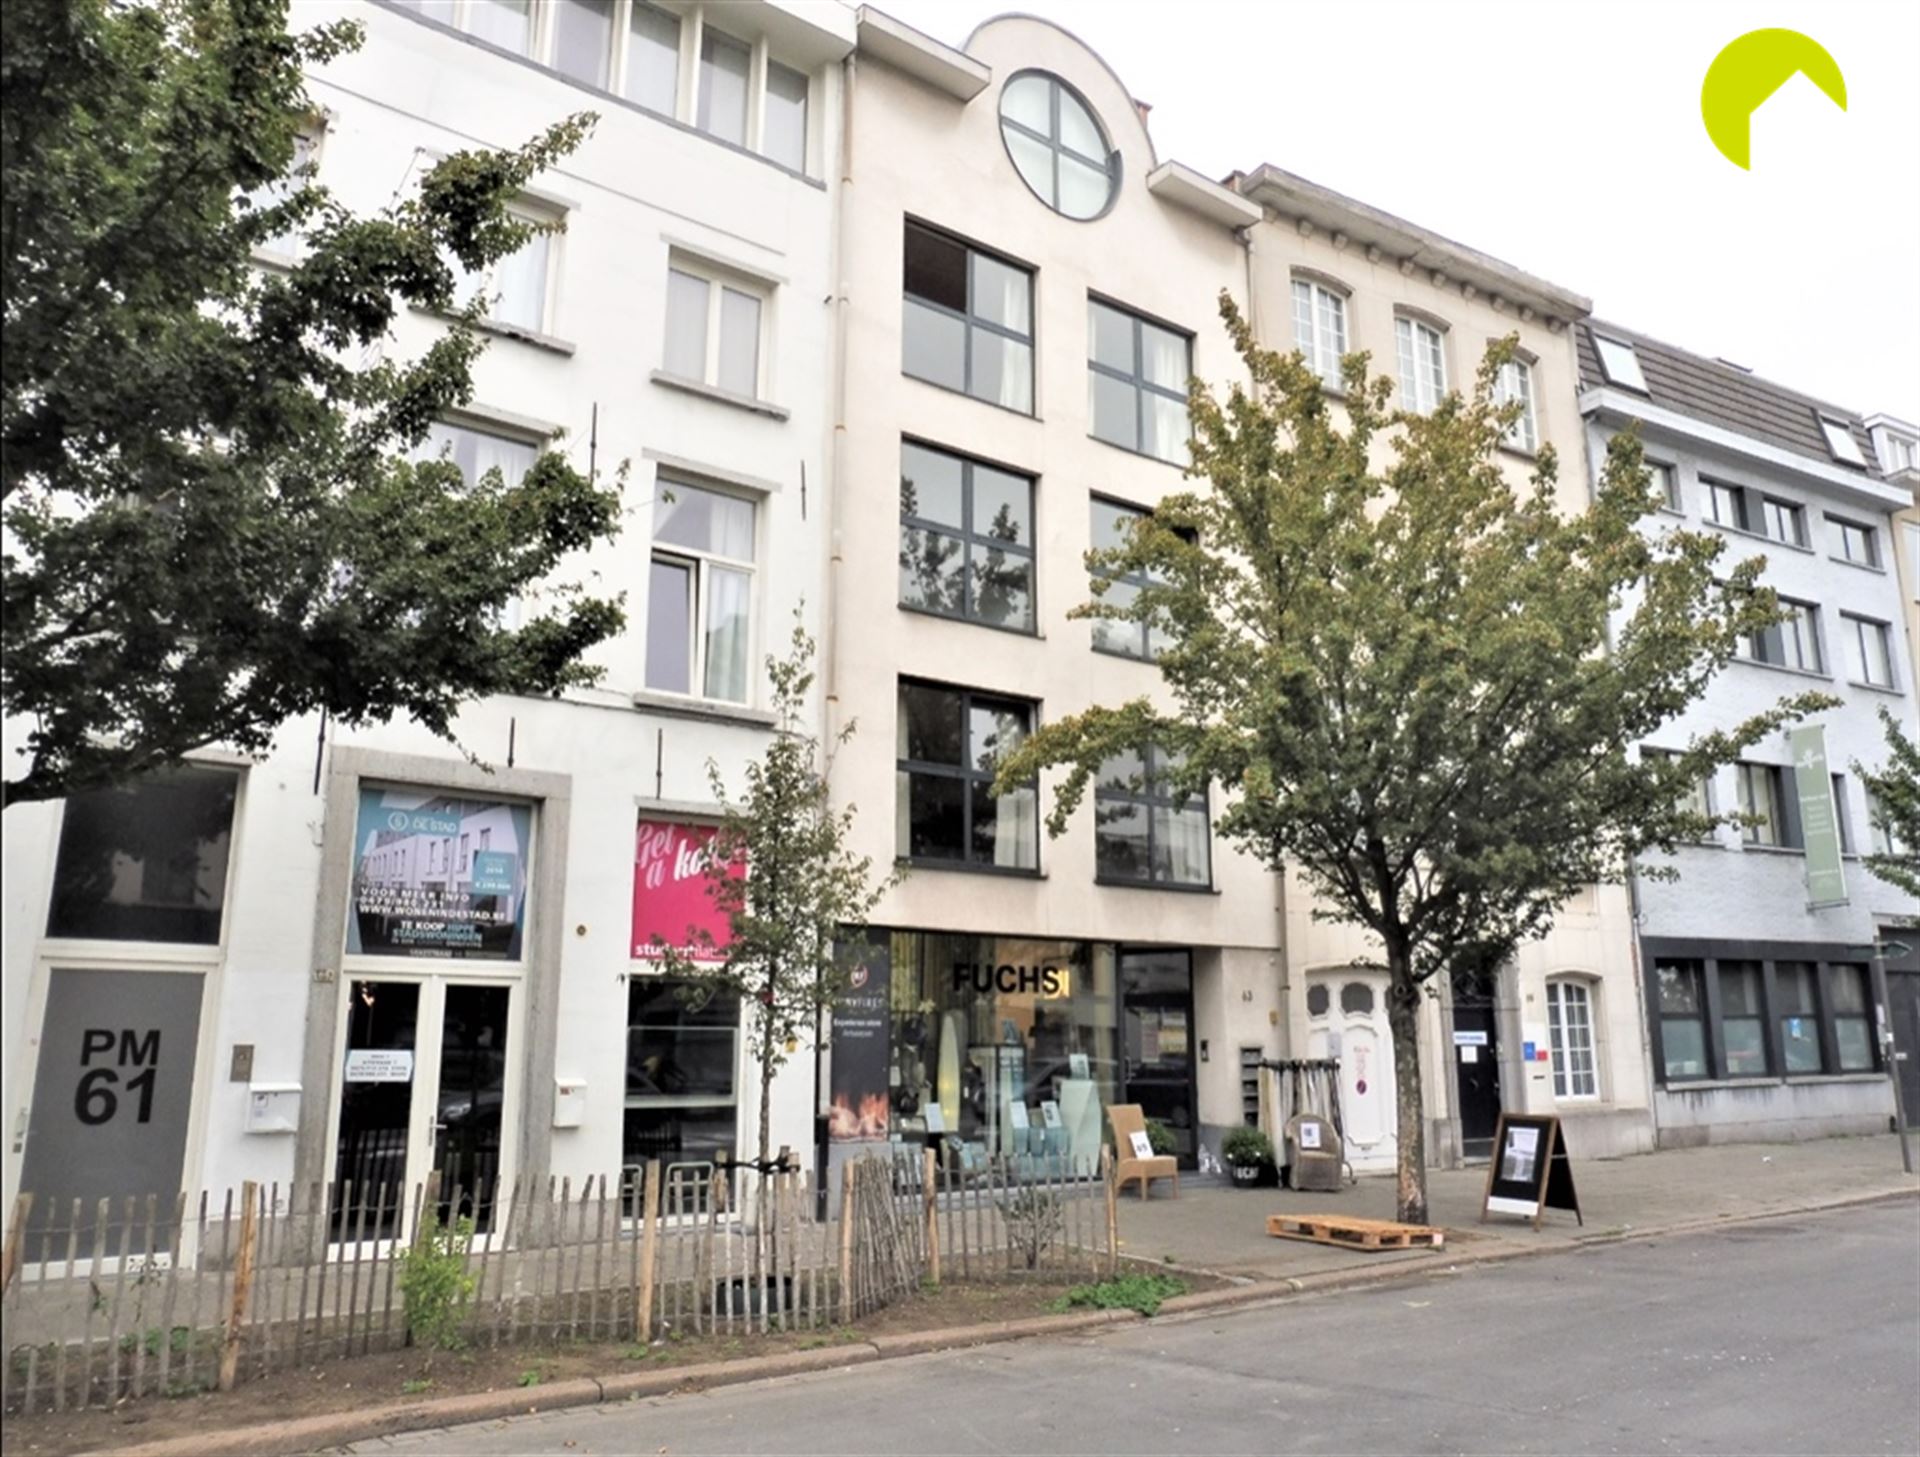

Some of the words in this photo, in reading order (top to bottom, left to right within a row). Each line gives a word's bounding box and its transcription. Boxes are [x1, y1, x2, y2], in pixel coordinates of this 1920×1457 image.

[361, 886, 396, 898] VOOR
[401, 888, 438, 900] MEER
[440, 892, 470, 904] INFO
[401, 920, 414, 929] TE
[416, 921, 445, 931] KOOP
[953, 963, 1060, 995] FUCHS
[80, 1029, 161, 1066] PM
[74, 1068, 156, 1126] 61
